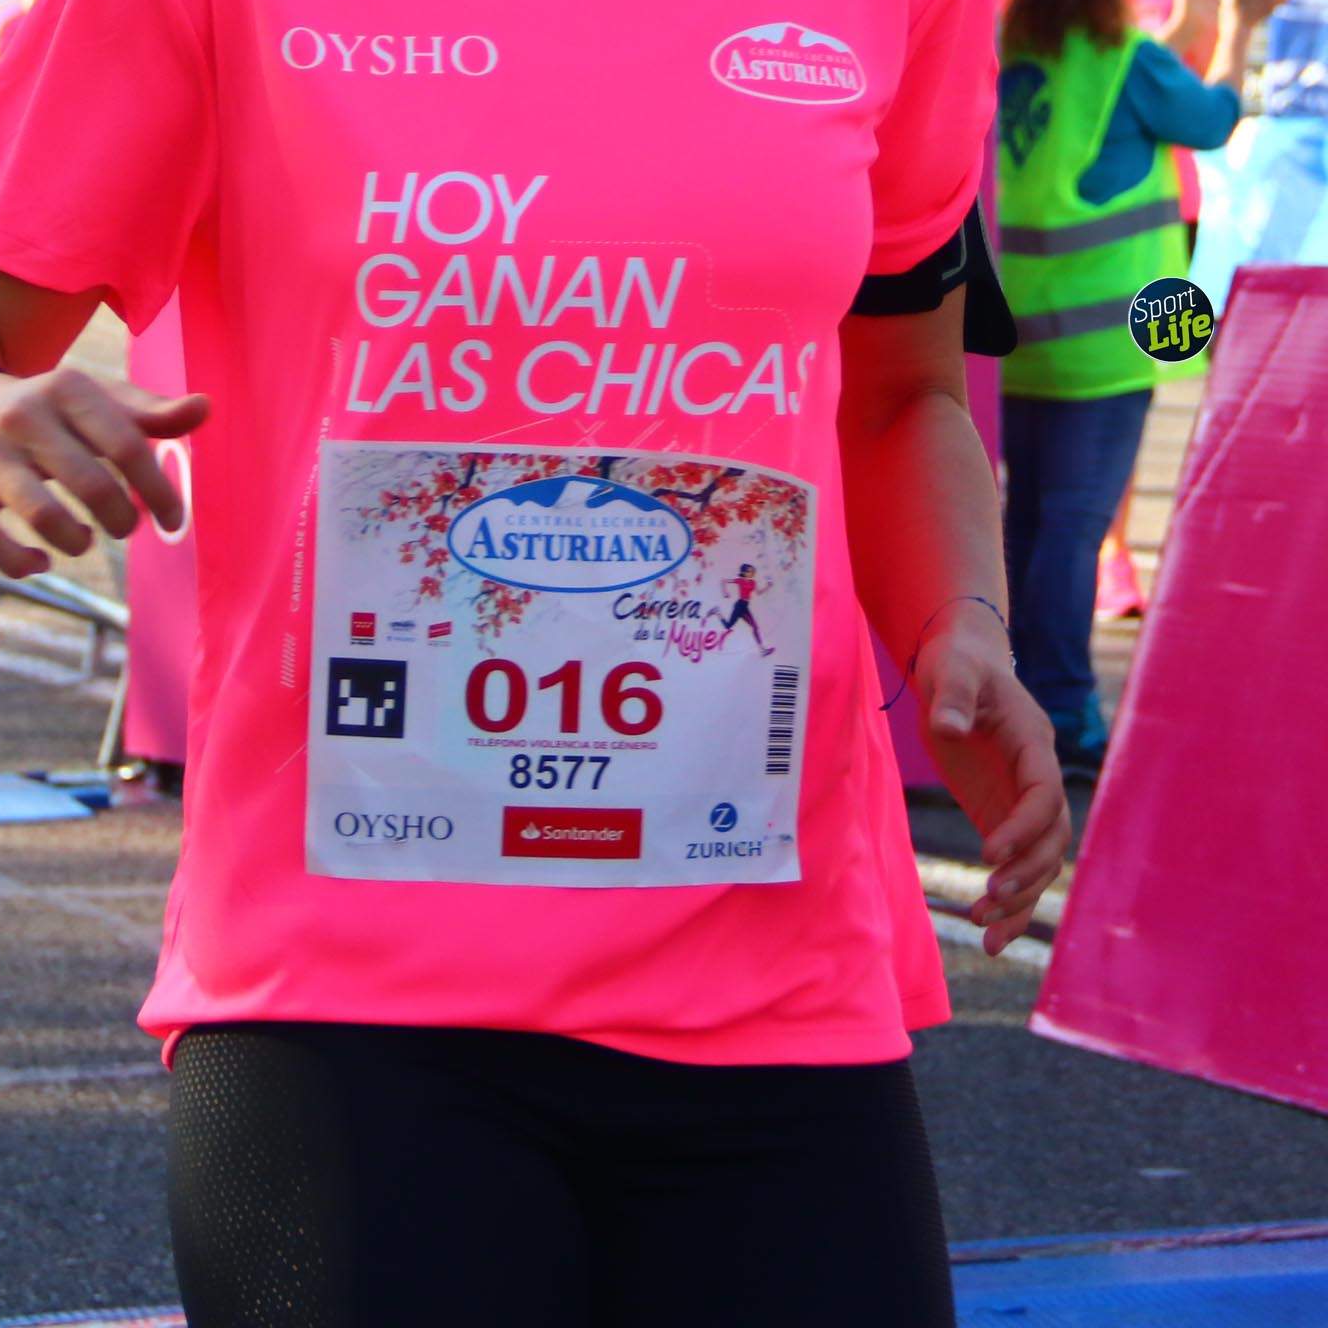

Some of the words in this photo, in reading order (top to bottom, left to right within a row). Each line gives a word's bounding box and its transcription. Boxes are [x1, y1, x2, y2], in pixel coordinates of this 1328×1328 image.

[280, 26, 500, 77] OYSHO
[724, 49, 859, 90] ASTURIANA
[356, 170, 549, 245] HOY
[355, 253, 687, 329] GANAN
[345, 339, 493, 413] LAS
[465, 516, 675, 562] ASTURIANA
[507, 514, 583, 528] CENTRAL
[591, 516, 668, 529] LECHERA
[613, 593, 702, 620] Carrera
[663, 620, 734, 663] Mujer
[465, 658, 664, 736] 016
[530, 739, 590, 749] VIOLENCIA
[593, 740, 608, 750] DE
[509, 754, 611, 790] 8577
[334, 812, 453, 840] OYSHO
[542, 824, 624, 841] Santander
[685, 841, 762, 860] ZURICH
